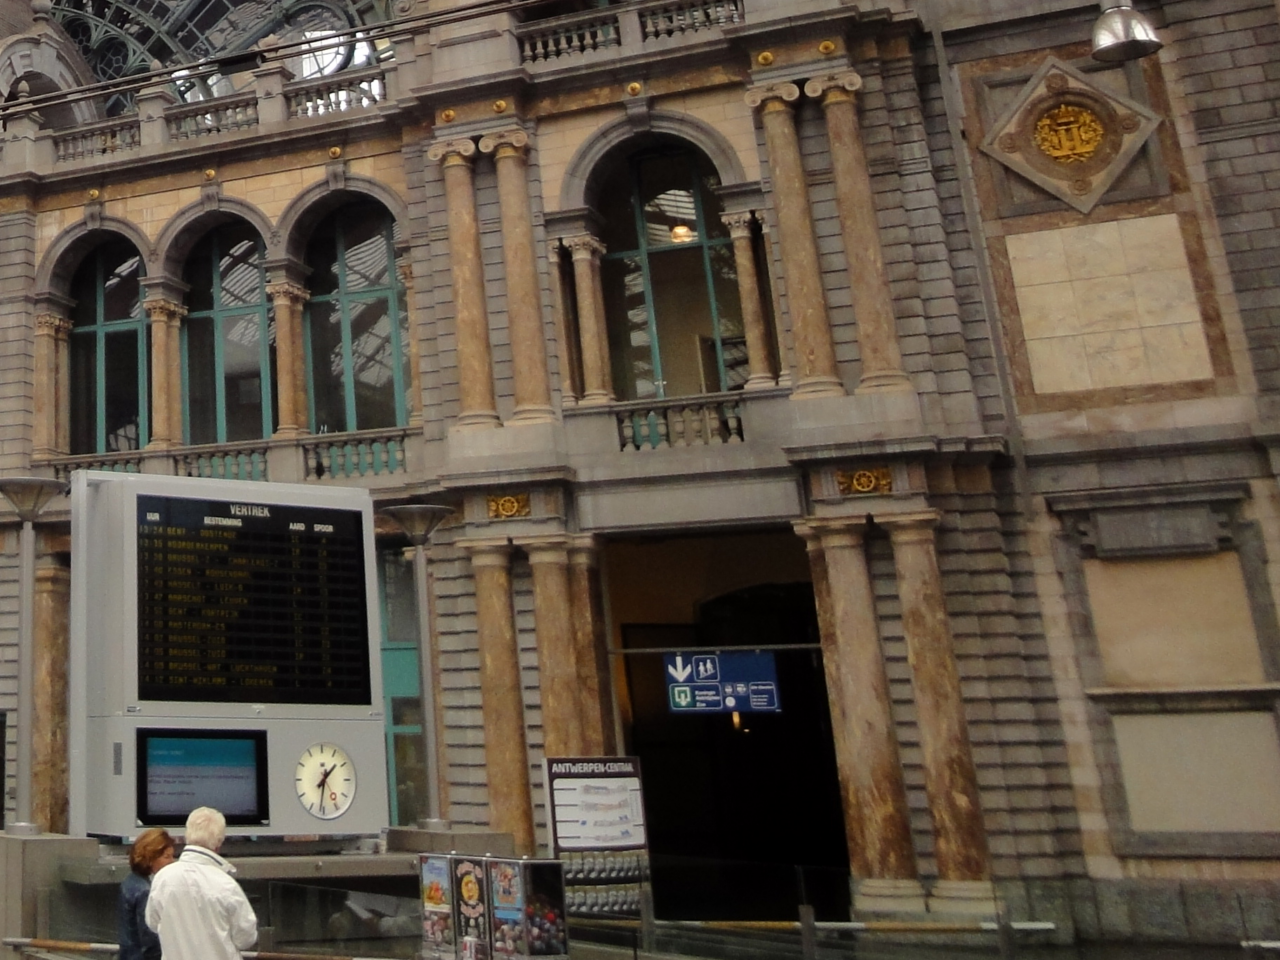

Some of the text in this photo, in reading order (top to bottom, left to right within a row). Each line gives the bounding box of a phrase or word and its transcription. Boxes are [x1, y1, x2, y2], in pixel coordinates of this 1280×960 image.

[230, 504, 270, 517] VERTREK
[204, 516, 242, 526] BESTEMMING
[289, 522, 305, 531] AARD
[314, 523, 333, 532] SPOOR
